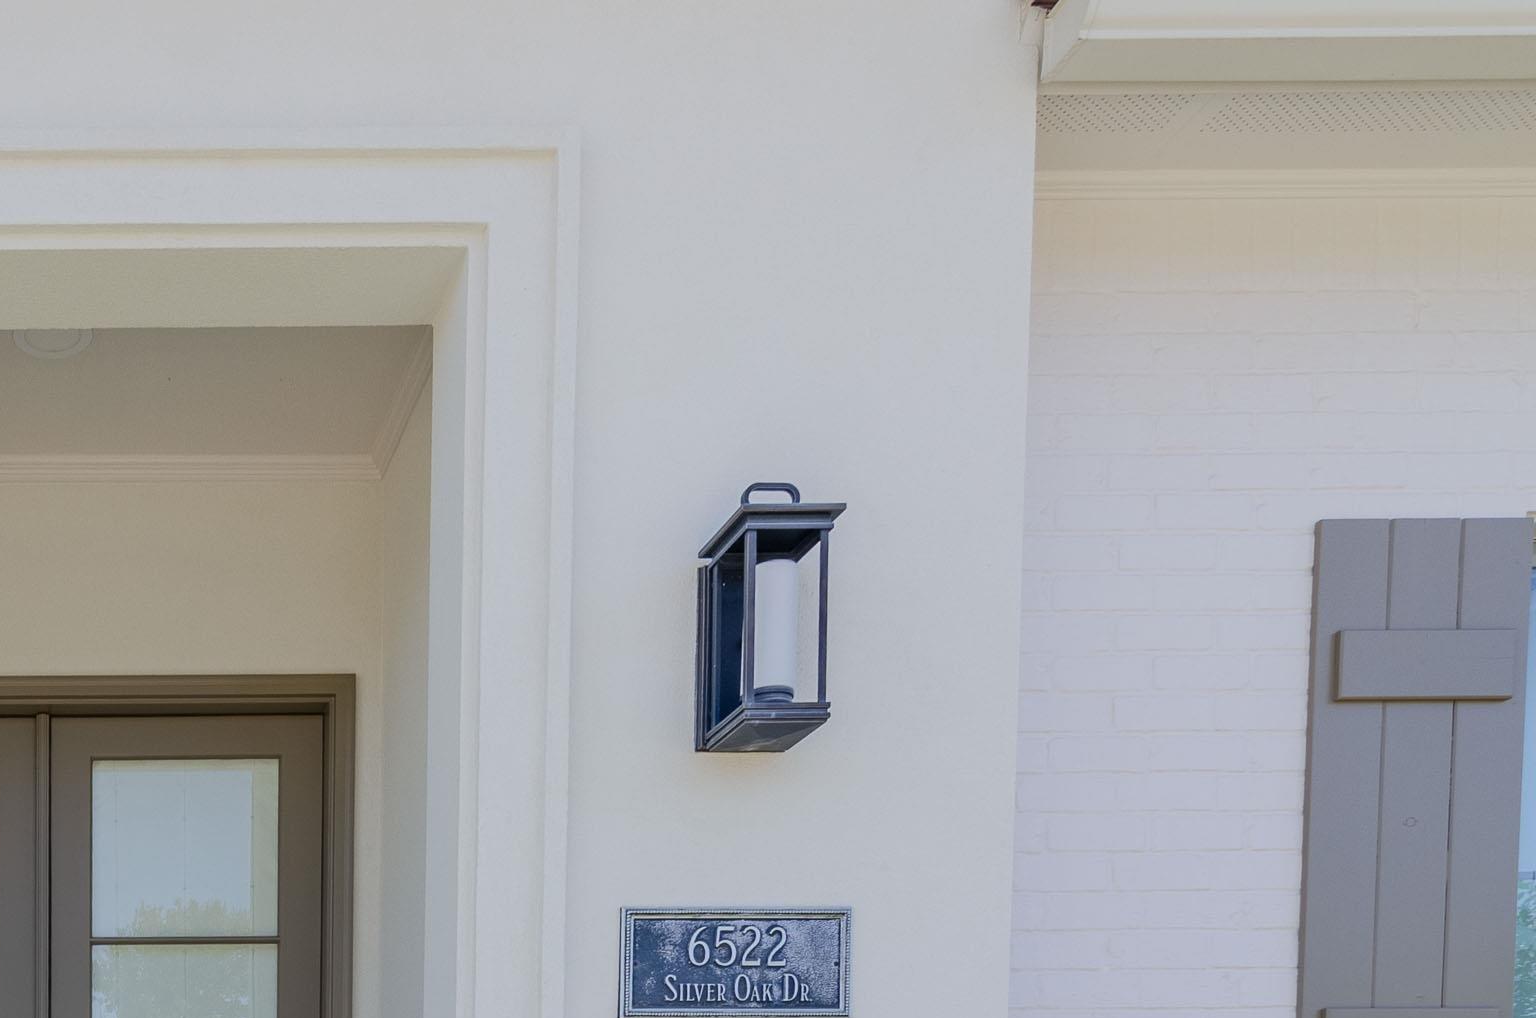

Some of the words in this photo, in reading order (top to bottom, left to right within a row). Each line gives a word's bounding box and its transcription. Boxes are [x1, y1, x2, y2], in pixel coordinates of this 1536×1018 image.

[688, 925, 787, 967] 6522
[664, 974, 726, 1002] SILVER
[734, 973, 773, 1002] OAK
